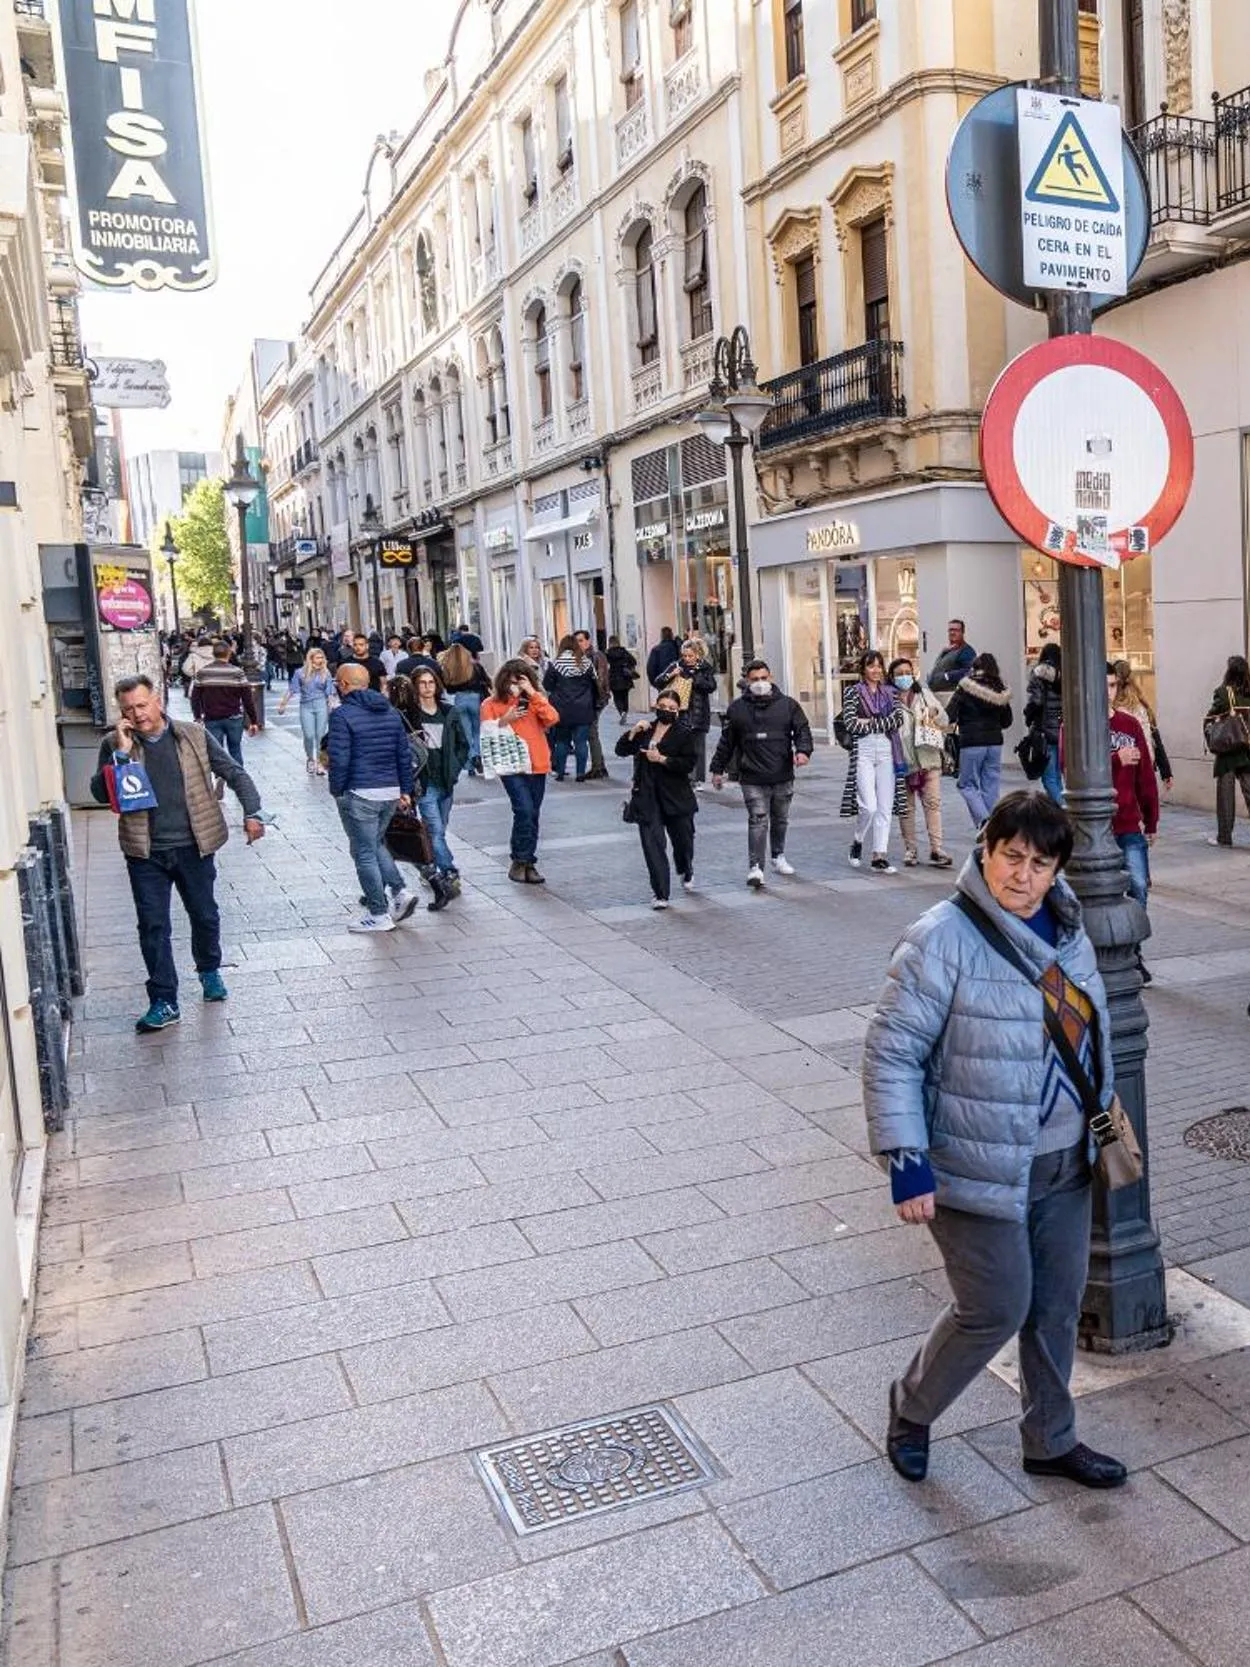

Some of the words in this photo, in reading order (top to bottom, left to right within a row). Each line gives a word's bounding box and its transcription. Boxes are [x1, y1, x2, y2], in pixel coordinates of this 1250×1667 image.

[88, 210, 198, 236] PROMOTORA
[1024, 212, 1071, 231] PELIGRO
[1074, 218, 1089, 233] DE
[1091, 219, 1122, 237] CAÍDA
[90, 229, 200, 254] INMOBILIARIA
[1037, 238, 1070, 254] CERA
[1076, 242, 1091, 256] EN
[1097, 244, 1112, 259] EL
[1040, 261, 1111, 282] PAVIMENTO
[686, 508, 725, 532] CALZEDONIA
[806, 520, 855, 550] PANDORA
